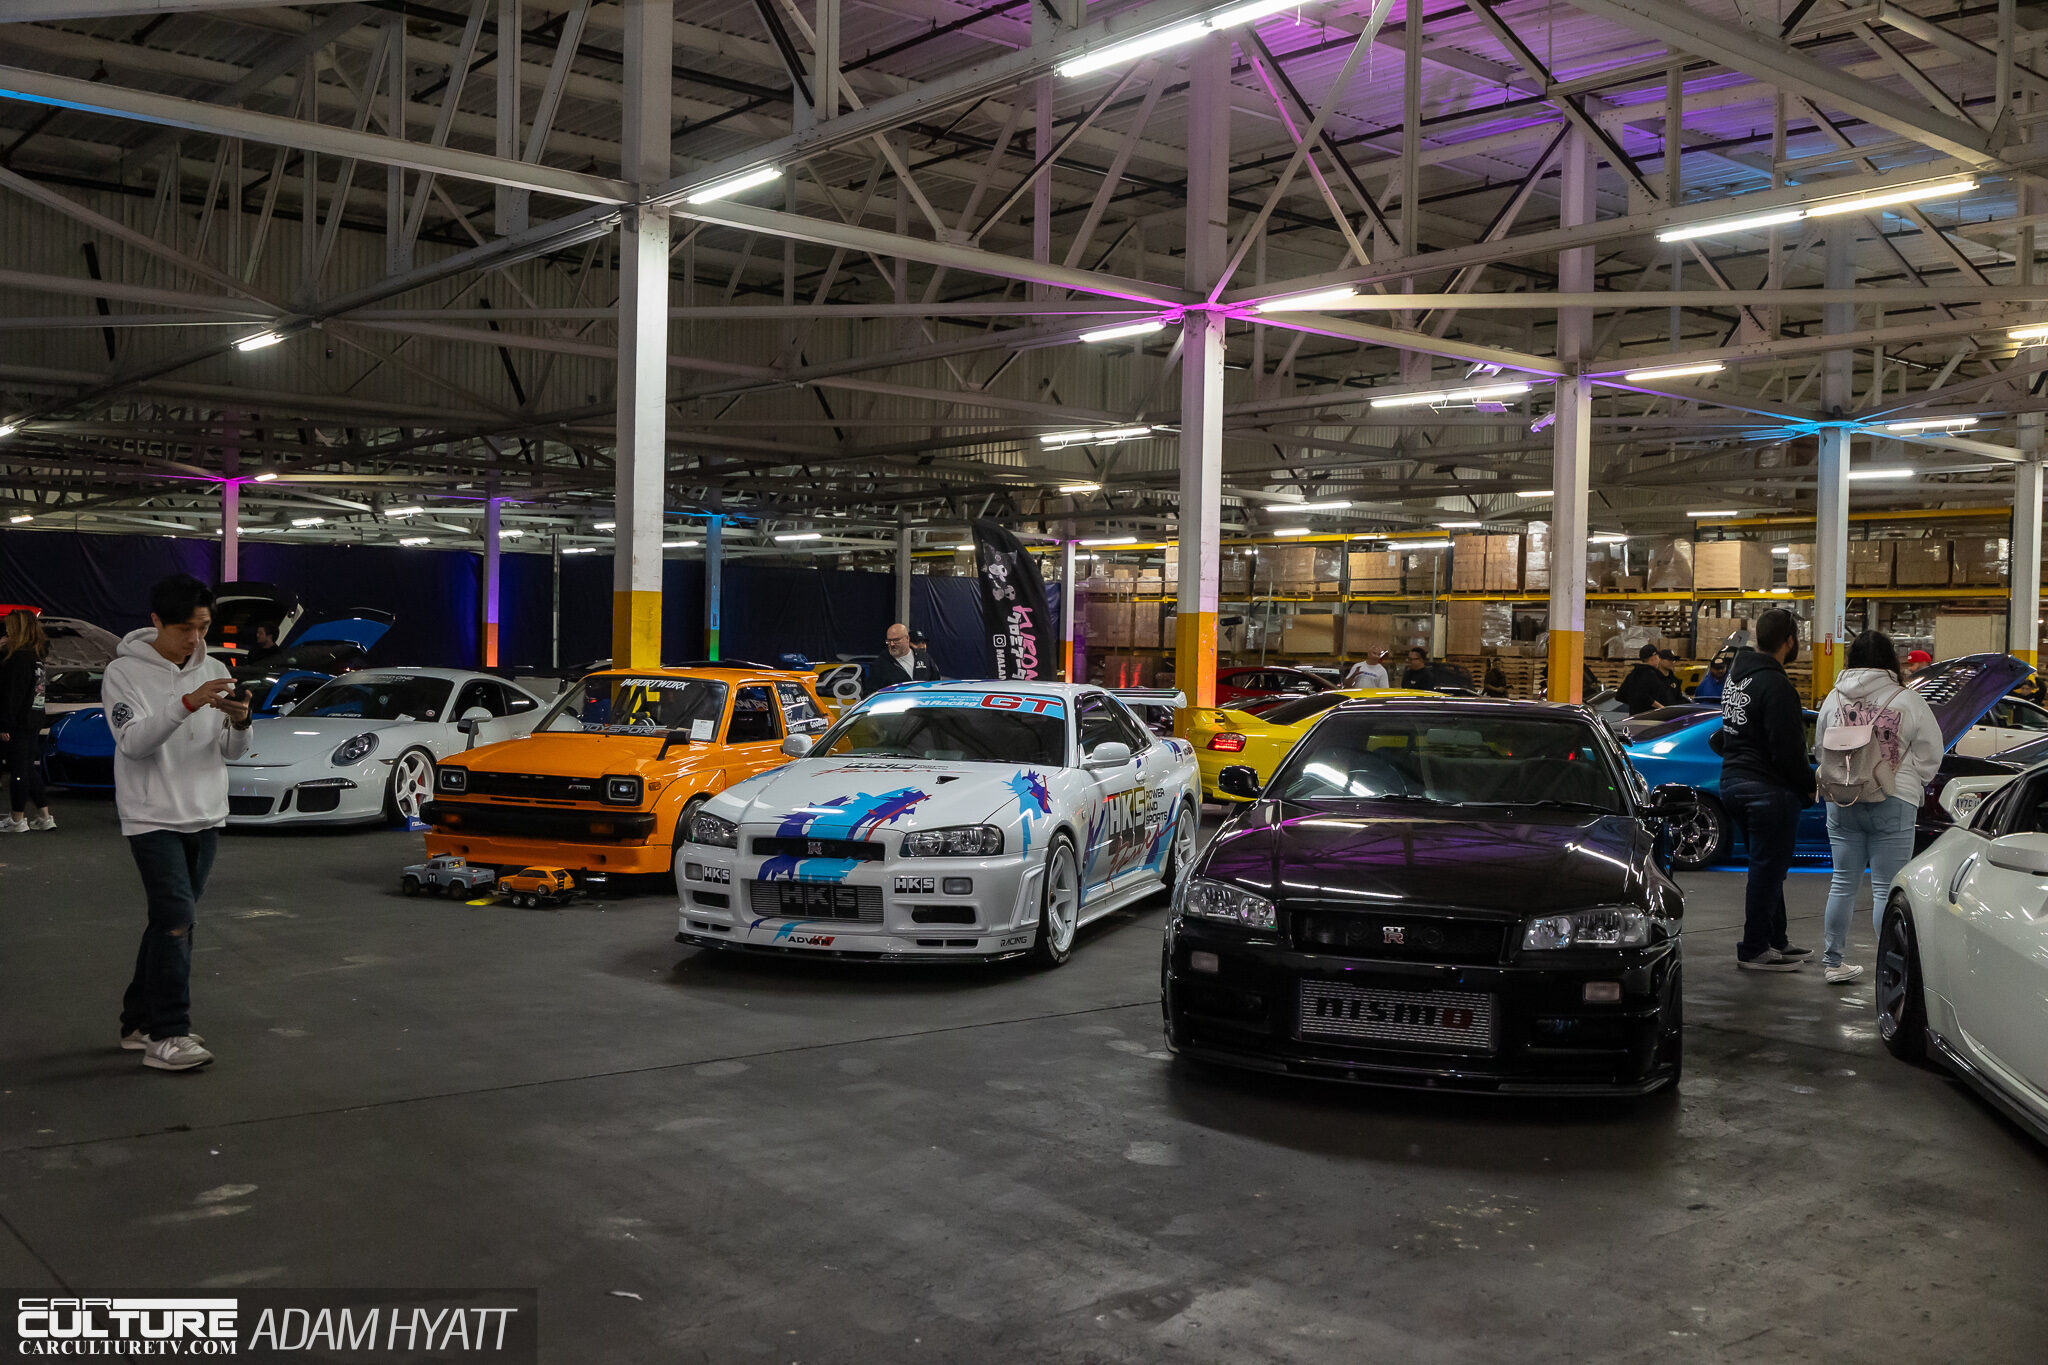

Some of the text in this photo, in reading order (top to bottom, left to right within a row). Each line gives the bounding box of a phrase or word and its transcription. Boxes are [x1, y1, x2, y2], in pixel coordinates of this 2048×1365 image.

[620, 678, 690, 691] IMPORTWORX
[930, 700, 978, 708] Racing
[980, 694, 1063, 714] GT
[1145, 788, 1165, 800] POWER
[1146, 801, 1159, 812] AND
[1109, 790, 1145, 836] HKS
[1146, 811, 1168, 826] SPORTS
[428, 874, 436, 883] 11
[704, 866, 730, 880] HKS
[895, 878, 934, 889] HKS
[781, 884, 856, 907] HKS
[788, 935, 831, 946] ADVAN
[1000, 935, 1027, 947] RACING
